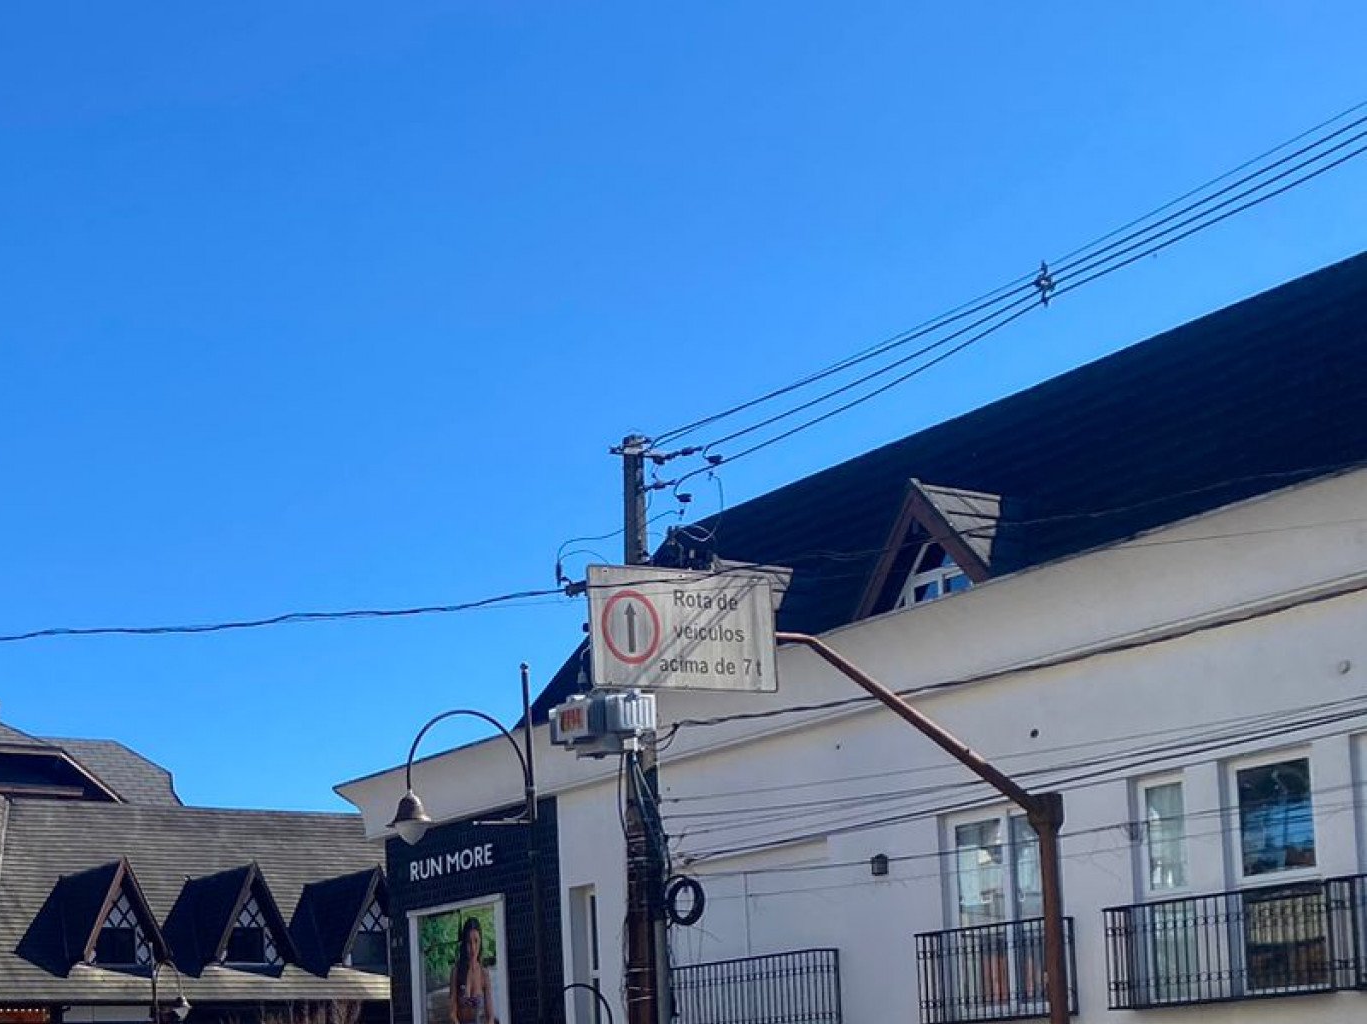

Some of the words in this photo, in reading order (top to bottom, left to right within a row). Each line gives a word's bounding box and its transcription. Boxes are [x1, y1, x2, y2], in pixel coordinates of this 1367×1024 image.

[673, 590, 712, 608] Rota
[717, 593, 738, 611] de
[659, 657, 709, 673] acima
[714, 658, 736, 675] de
[743, 658, 752, 675] 7
[409, 853, 443, 881] RUN
[446, 843, 494, 874] MORE
